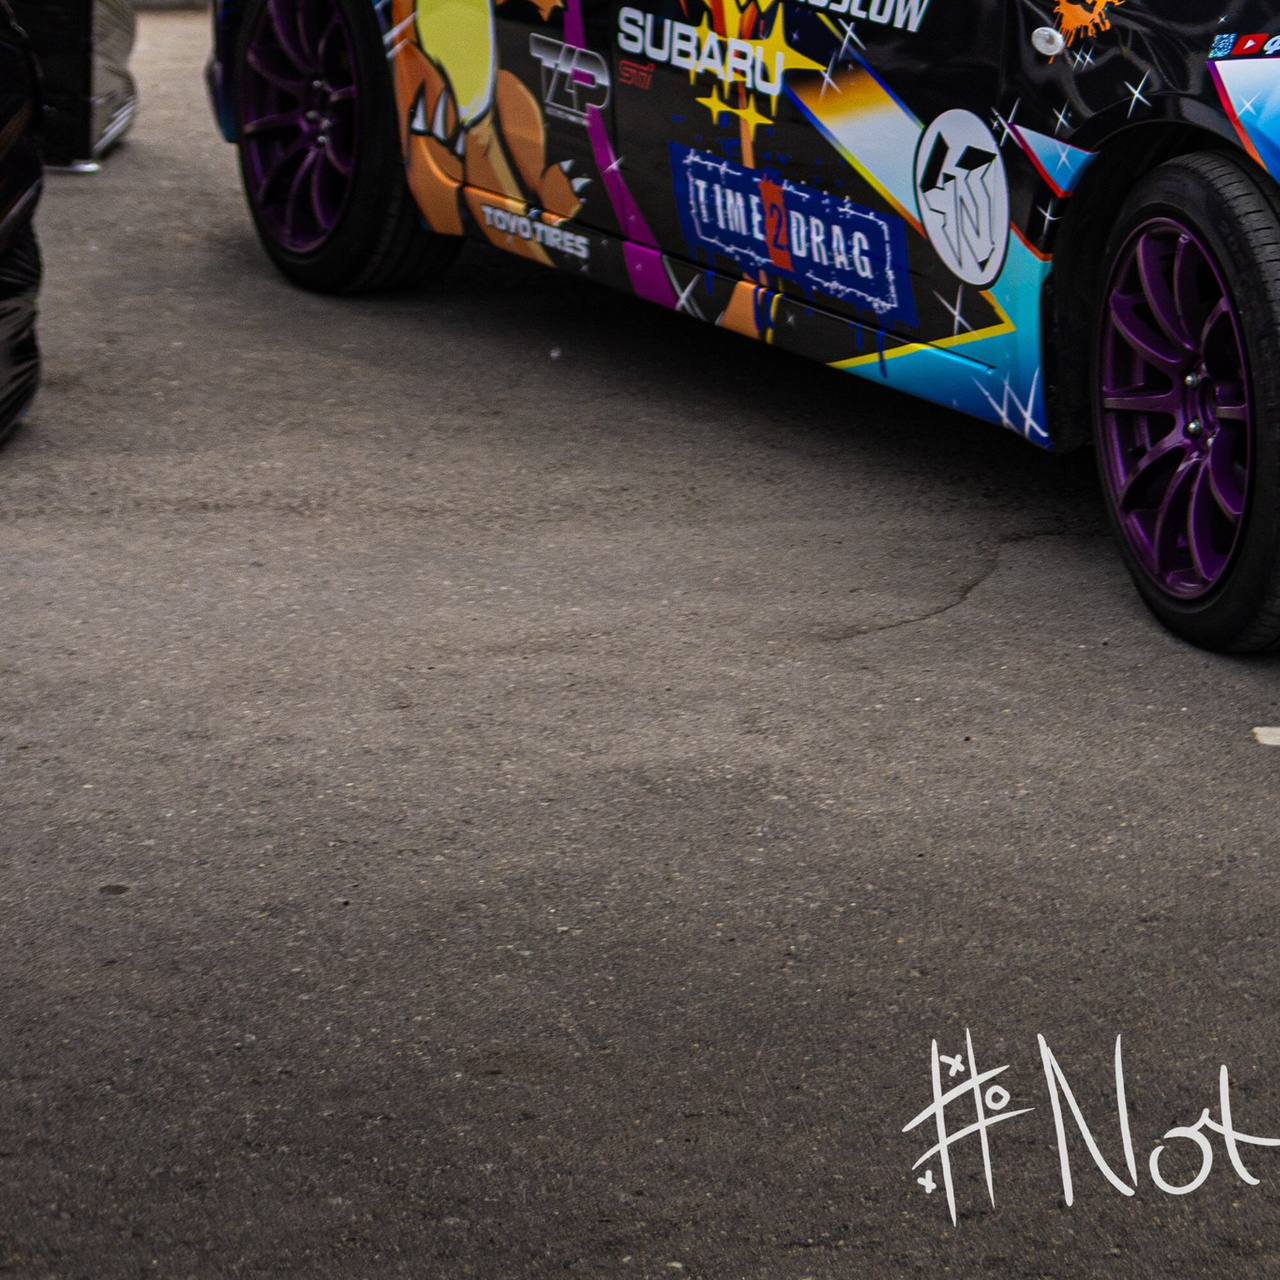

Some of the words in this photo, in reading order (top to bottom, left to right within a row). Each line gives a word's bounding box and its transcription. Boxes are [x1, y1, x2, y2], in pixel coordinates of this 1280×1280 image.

[617, 6, 785, 96] SUBARU
[482, 204, 532, 239] TOYO
[533, 220, 589, 259] TIRES
